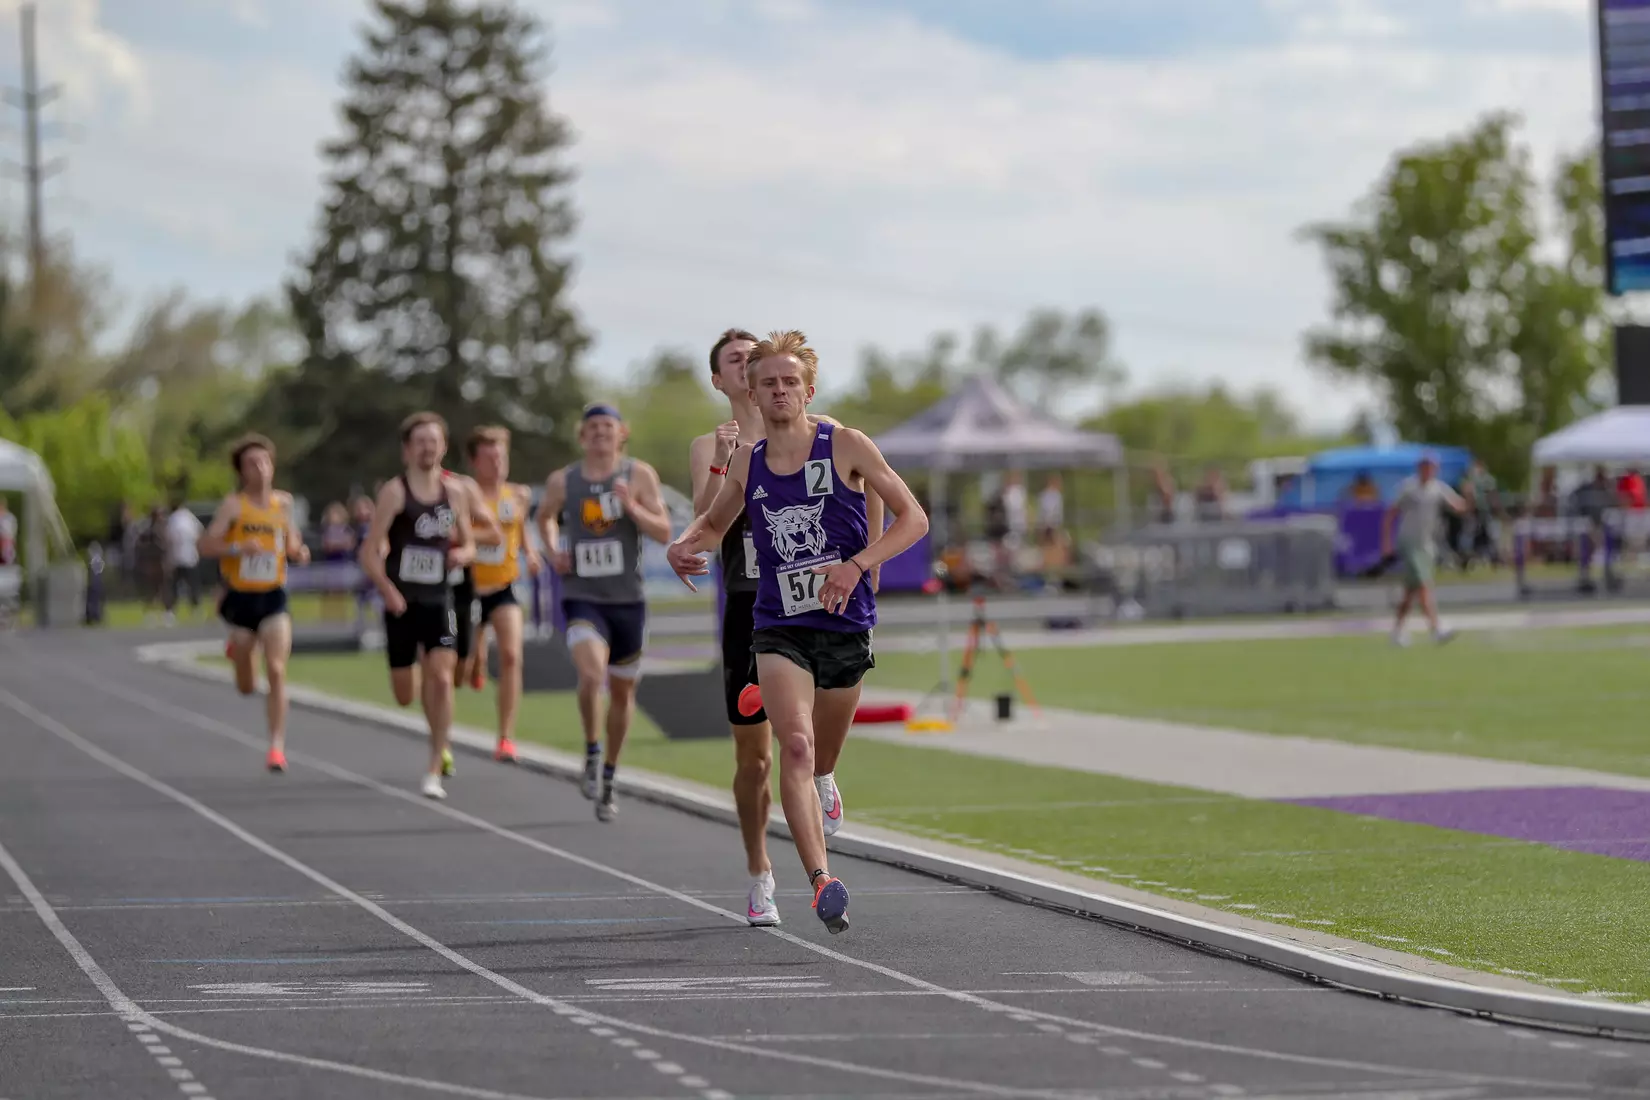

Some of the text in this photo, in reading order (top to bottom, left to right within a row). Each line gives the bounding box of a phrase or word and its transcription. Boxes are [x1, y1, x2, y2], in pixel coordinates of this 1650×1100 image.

[810, 462, 829, 494] 2
[752, 492, 769, 500] adidas
[794, 556, 826, 568] CHAMPIONSHIPS
[787, 564, 831, 602] 57
